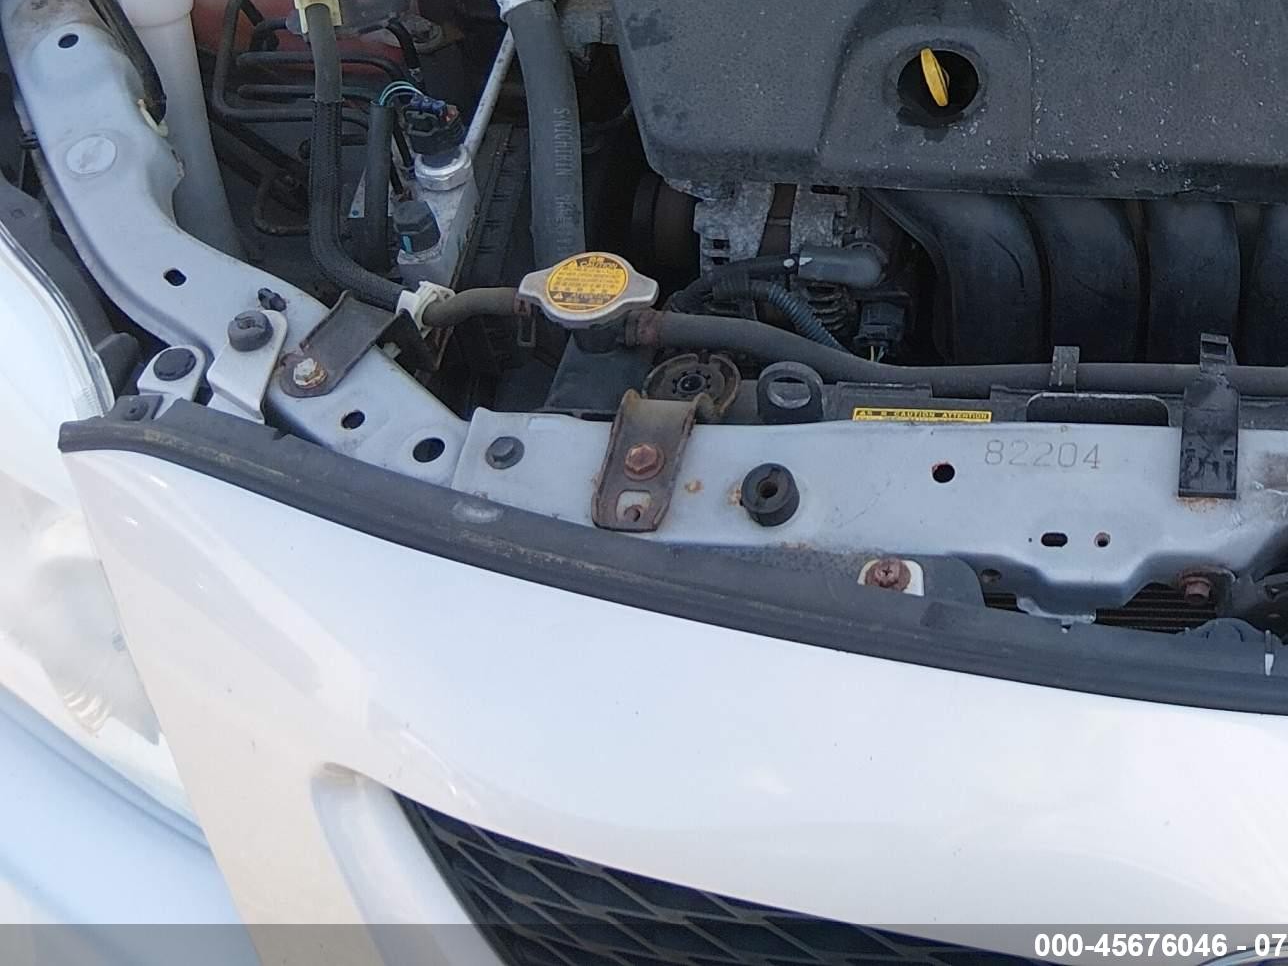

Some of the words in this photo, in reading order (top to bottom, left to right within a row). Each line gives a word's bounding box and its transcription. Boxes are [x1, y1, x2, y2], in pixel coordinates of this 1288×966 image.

[894, 410, 935, 418] CAUTION
[941, 411, 987, 419] ATTENTION
[984, 439, 1101, 469] 82204
